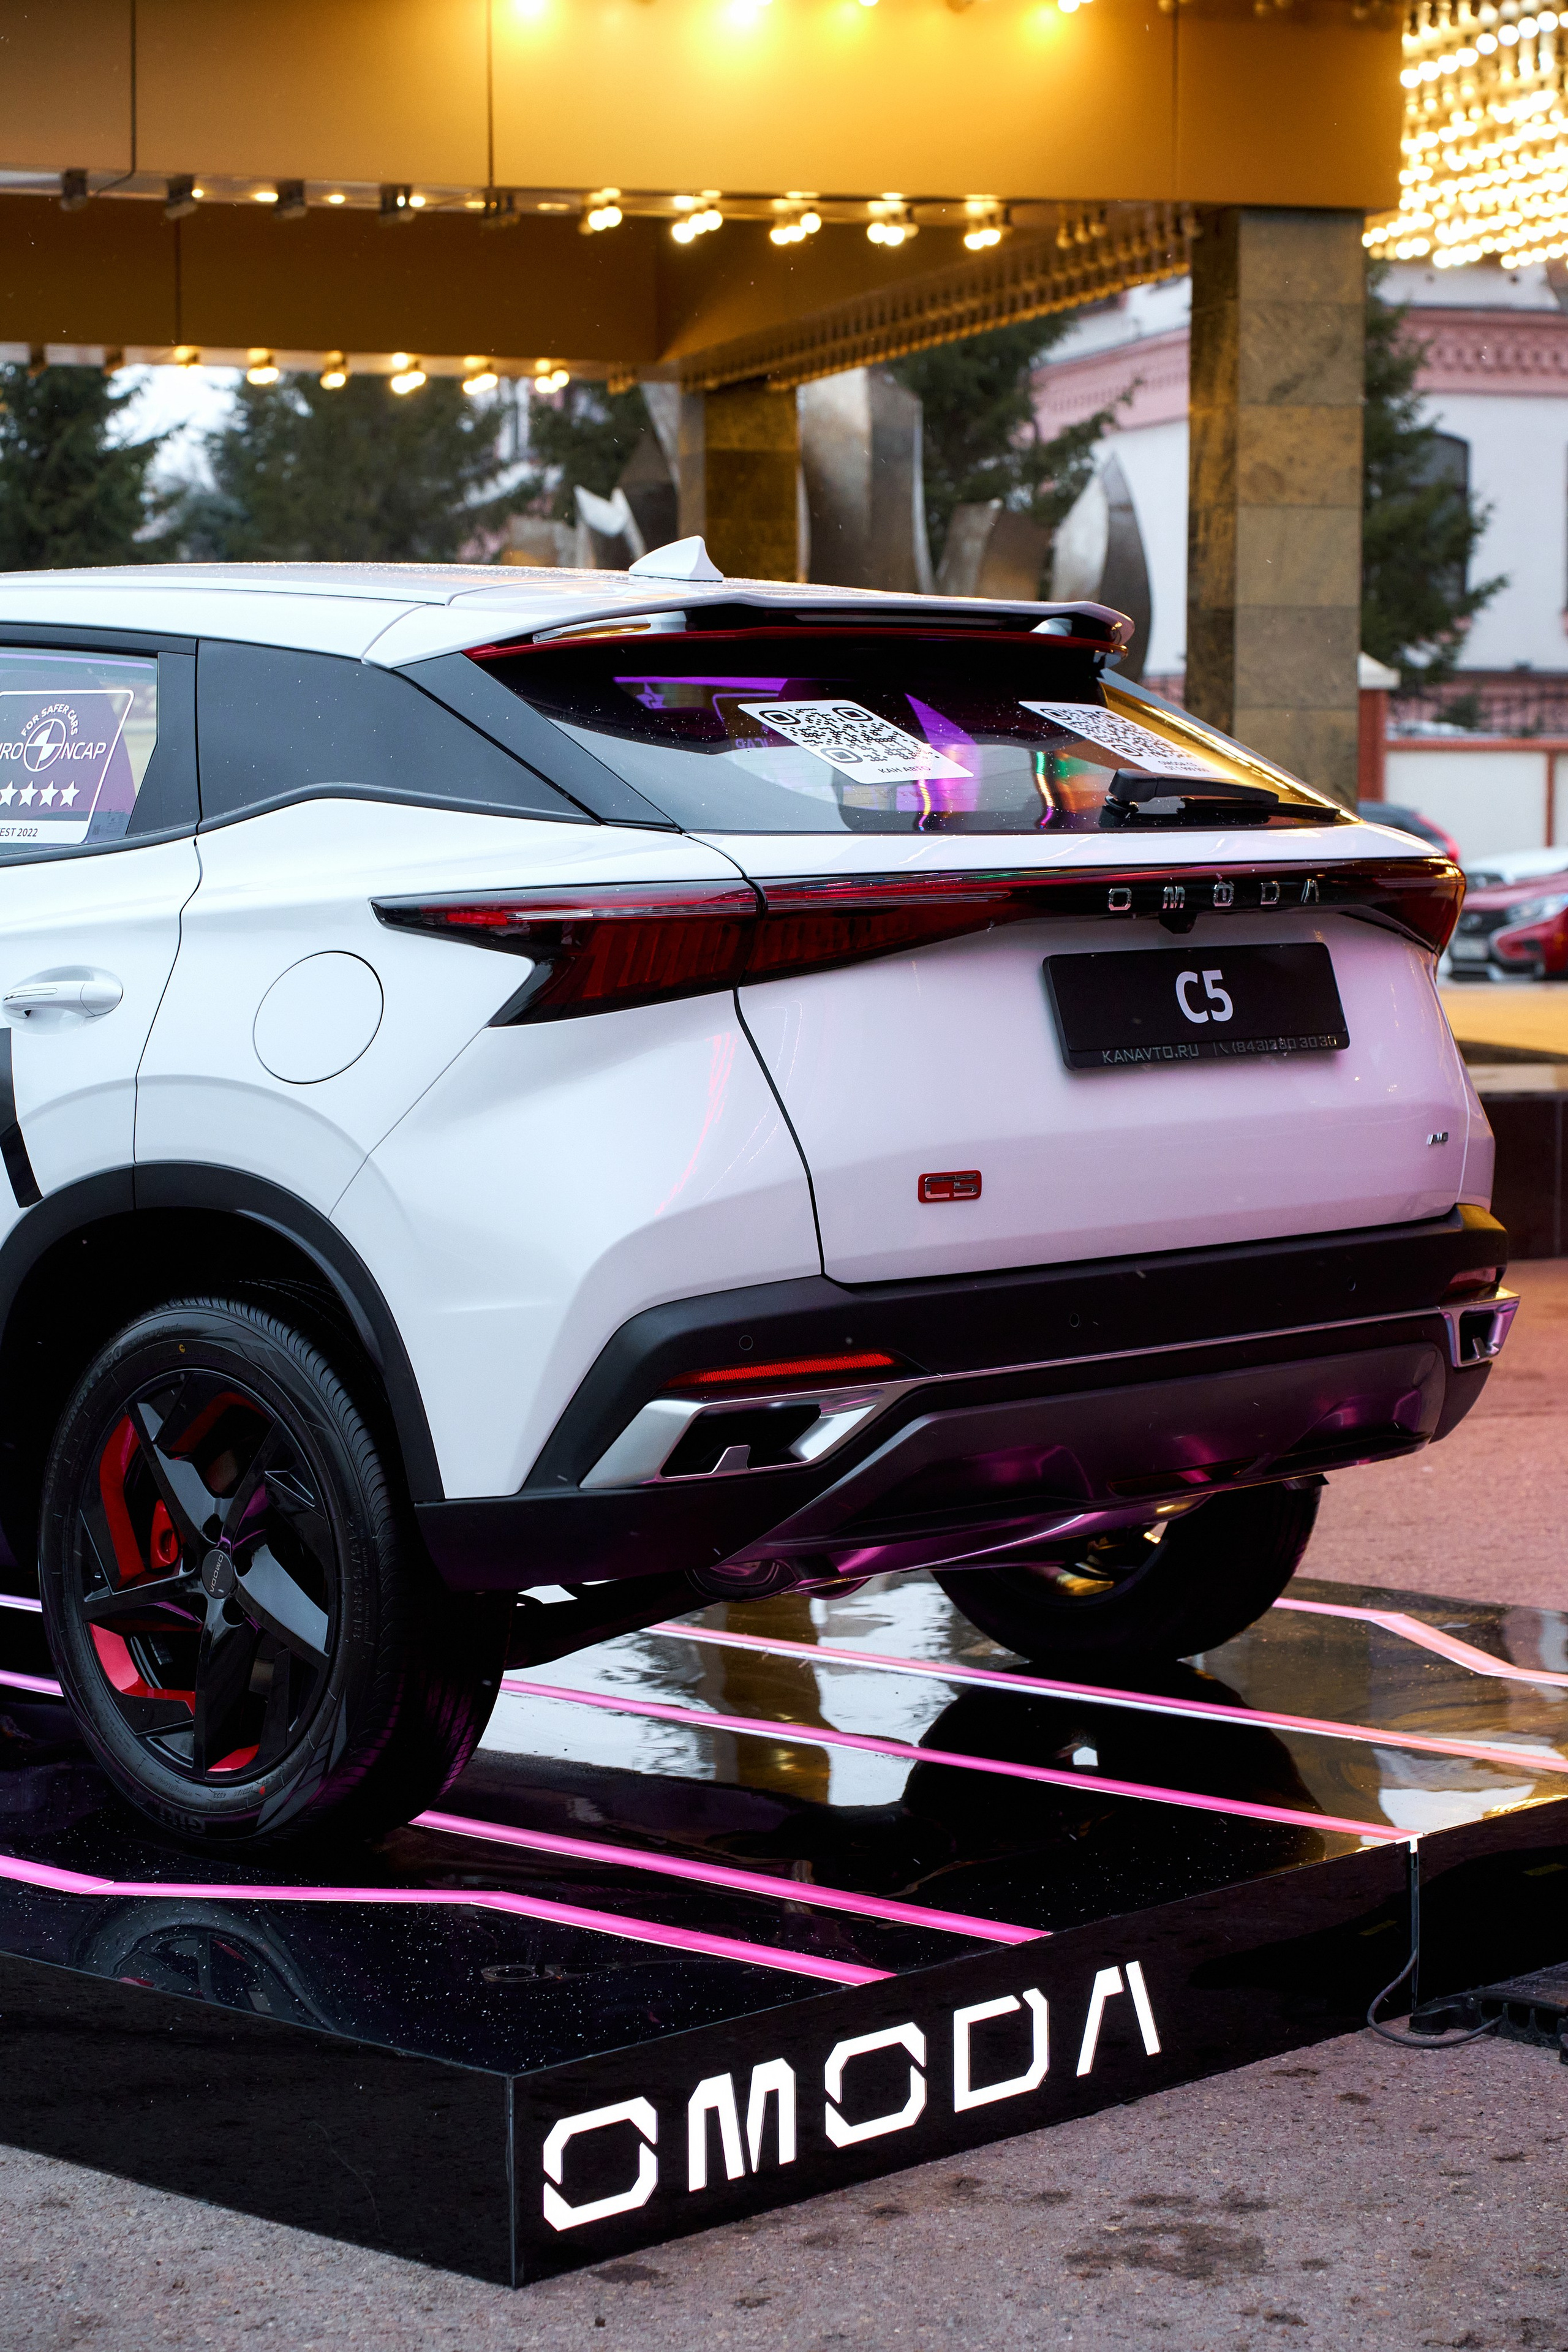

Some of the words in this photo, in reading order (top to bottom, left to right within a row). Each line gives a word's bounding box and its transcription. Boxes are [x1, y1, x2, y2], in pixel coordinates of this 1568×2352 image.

[21, 714, 40, 736] FOR
[41, 704, 70, 717] SAFER
[67, 709, 79, 736] CARS
[0, 742, 24, 760] RO
[61, 742, 107, 760] NCAP
[0, 827, 17, 837] EST
[17, 827, 38, 837] 2022
[1108, 879, 1320, 911] OMODA
[1175, 970, 1234, 1023] C5
[1102, 1044, 1199, 1063] KANAVTO.RU
[209, 1554, 224, 1593] OMODA
[543, 1960, 1161, 2231] OMODA
